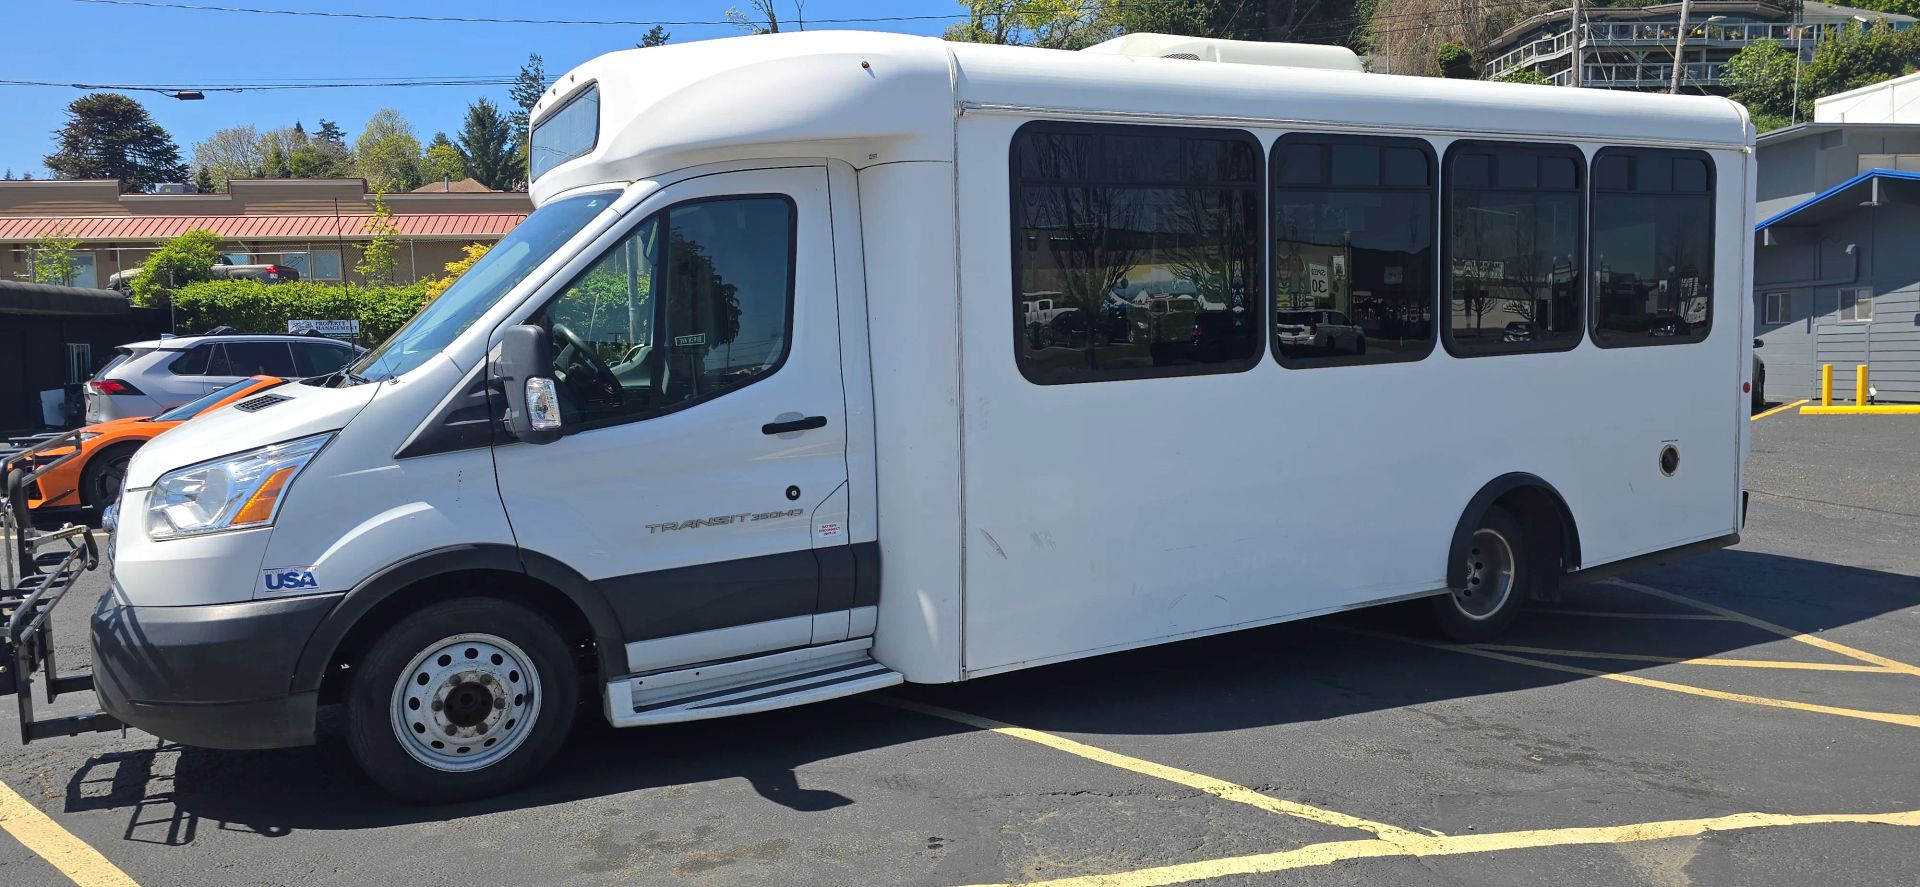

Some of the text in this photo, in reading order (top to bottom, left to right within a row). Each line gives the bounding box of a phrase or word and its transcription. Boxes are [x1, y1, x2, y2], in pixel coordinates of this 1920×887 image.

[645, 508, 804, 534] TRANSIT 350HD
[265, 571, 318, 590] USA
